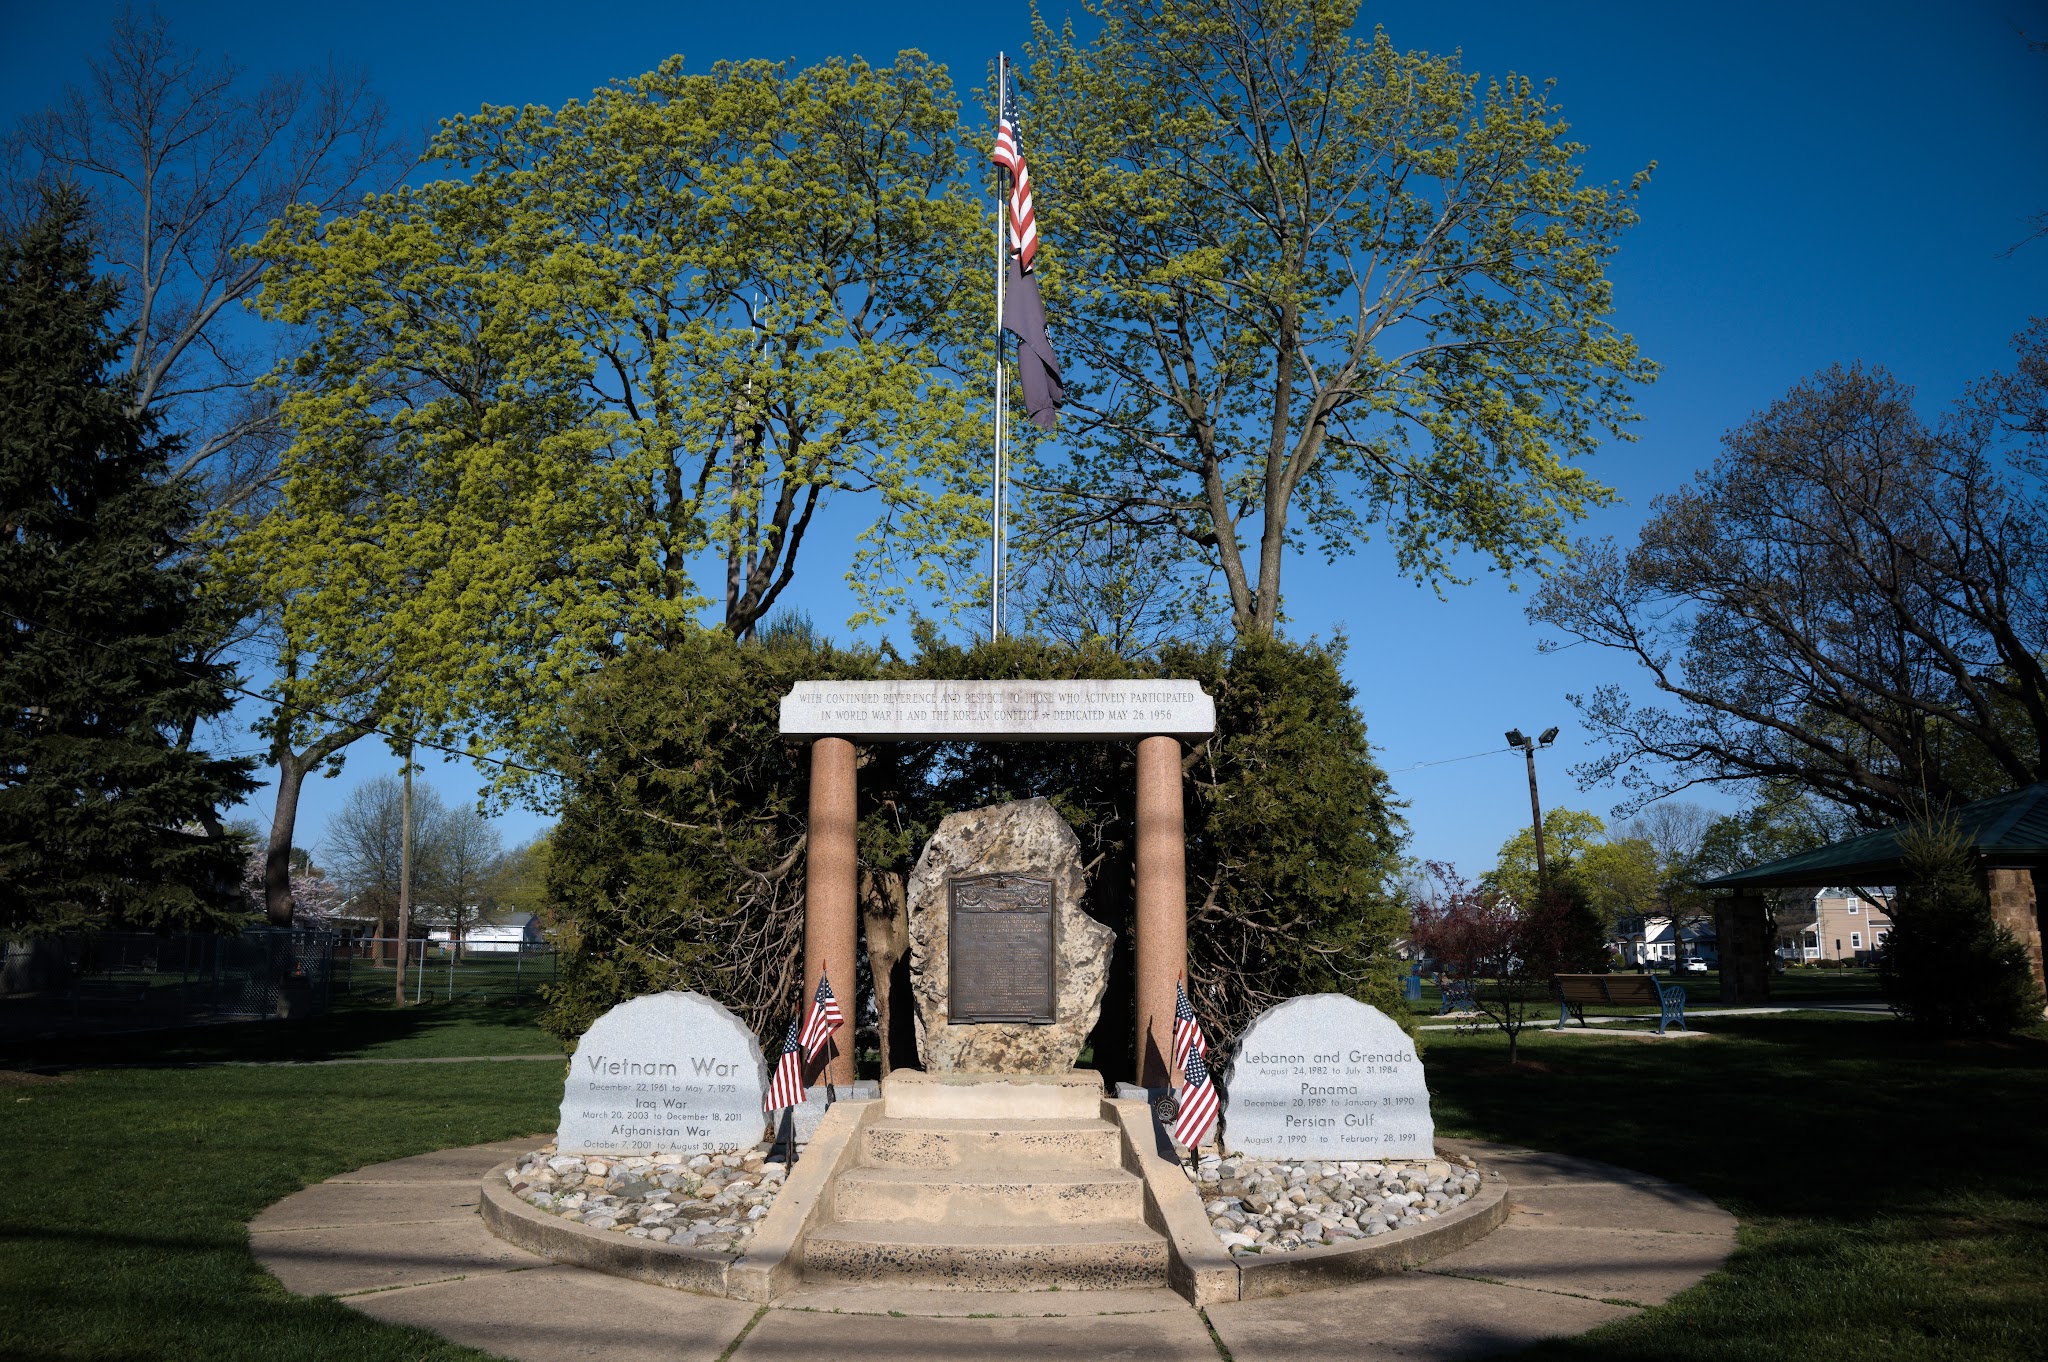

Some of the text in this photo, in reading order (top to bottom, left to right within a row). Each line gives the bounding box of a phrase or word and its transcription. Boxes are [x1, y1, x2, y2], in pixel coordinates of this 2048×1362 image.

[799, 693, 1194, 704] WITH CONTINUED REVERENCE AND RESPECT TO THOSE WHO ACTIVELY PARTICIPATED
[821, 711, 830, 721] IN
[836, 711, 867, 721] WORLD
[872, 711, 891, 721] WAR
[896, 710, 903, 721] II
[907, 711, 926, 721] AND
[932, 710, 948, 721] THE
[953, 710, 990, 721] KOREAN
[994, 710, 1039, 720] CONFLICT
[1054, 710, 1104, 720] DEDICATED
[1108, 710, 1128, 720] MAY
[1150, 710, 1171, 720] 1956
[1245, 1050, 1411, 1064] Lebanon and Grenada
[588, 1055, 739, 1077] Vietnam War
[1260, 1067, 1288, 1076] August
[1345, 1067, 1361, 1076] July
[590, 1083, 632, 1091] December
[686, 1085, 702, 1094] May
[1301, 1083, 1357, 1095] Panama
[636, 1099, 687, 1110] Iraq War
[1244, 1099, 1286, 1107] December
[1331, 1099, 1339, 1107] to
[1345, 1099, 1377, 1107] January
[667, 1113, 708, 1121] December
[1286, 1114, 1374, 1127] Persian Gulf
[611, 1125, 710, 1137] Afghanistan War
[1244, 1136, 1272, 1144] August
[1341, 1134, 1378, 1143] February
[584, 1140, 618, 1148] October
[633, 1141, 652, 1149] 2001
[658, 1142, 665, 1150] to
[670, 1142, 700, 1151] August
[703, 1142, 715, 1151] 30,
[719, 1143, 738, 1151] 2021
